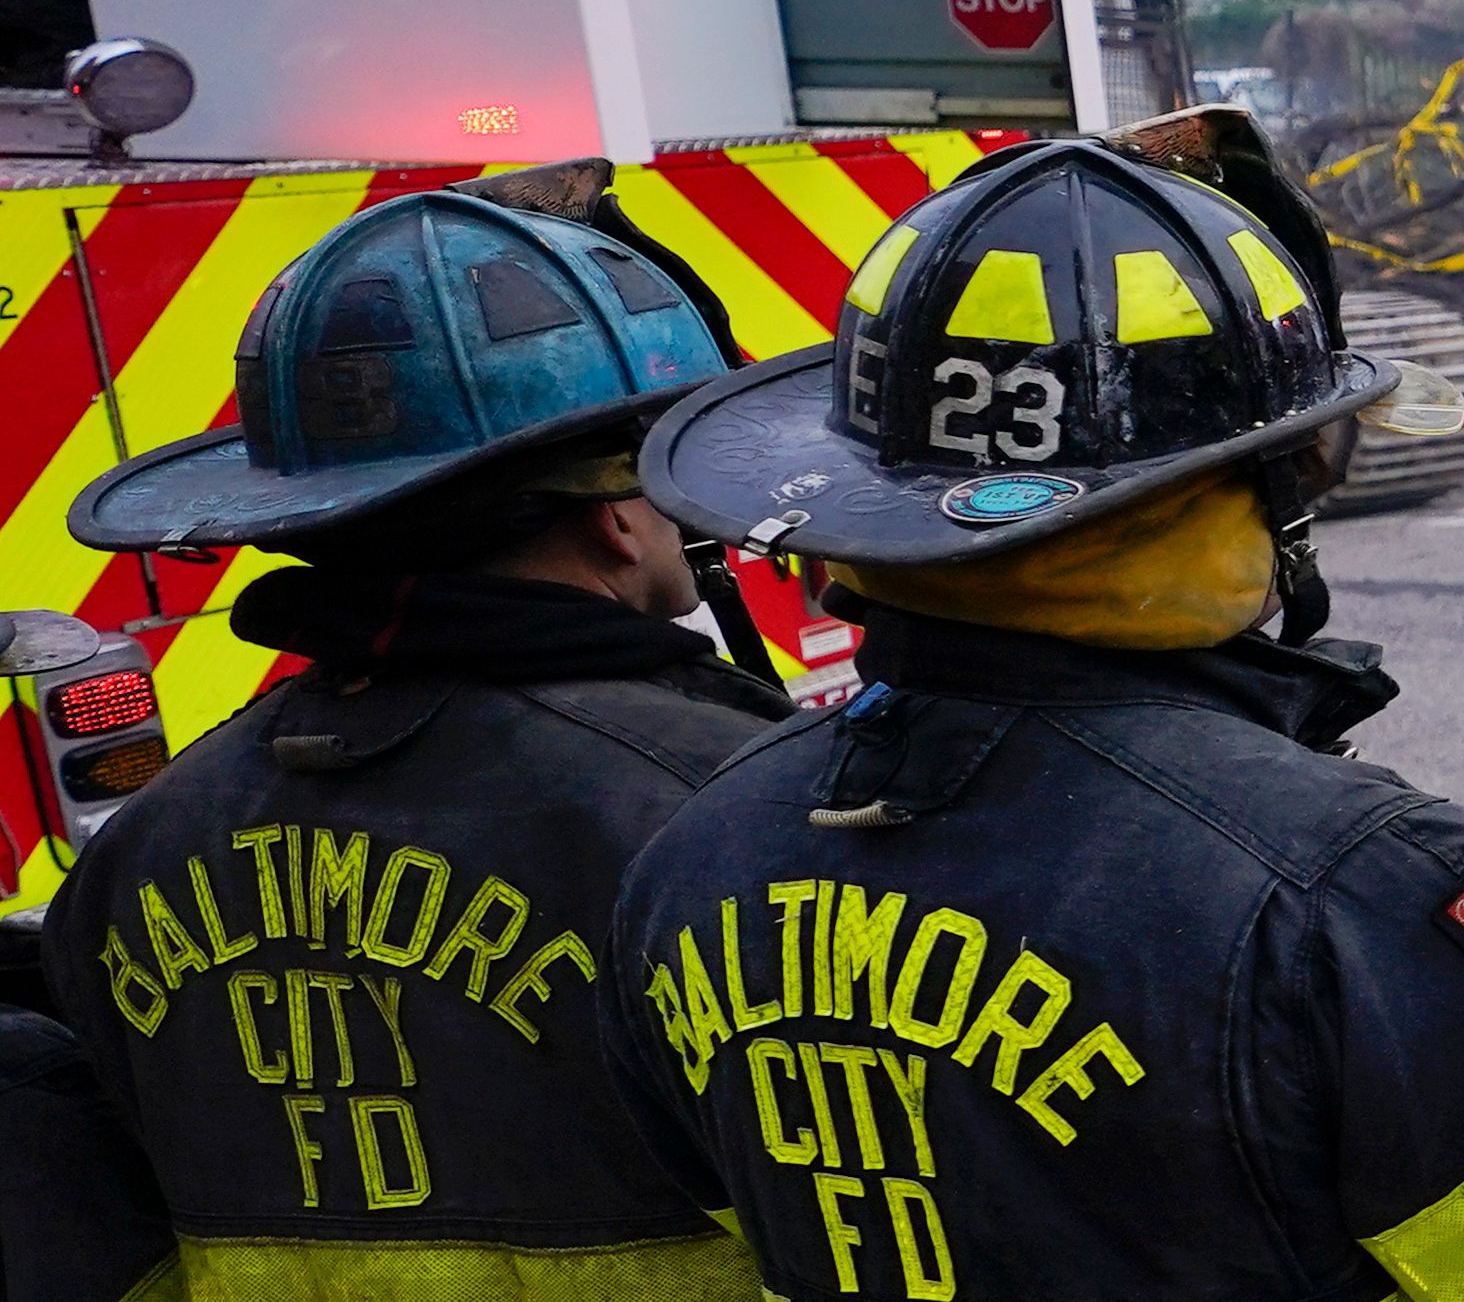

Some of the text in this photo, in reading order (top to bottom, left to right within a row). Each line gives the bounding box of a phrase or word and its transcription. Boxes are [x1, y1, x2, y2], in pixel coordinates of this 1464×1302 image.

[930, 357, 1062, 463] 23
[99, 823, 597, 1038] BALTIMORE
[227, 968, 416, 1088] CITY
[645, 879, 1145, 1146] BALTIMORE
[282, 1095, 431, 1209] FD
[746, 1038, 936, 1178] CITY
[813, 1173, 956, 1302] FD
